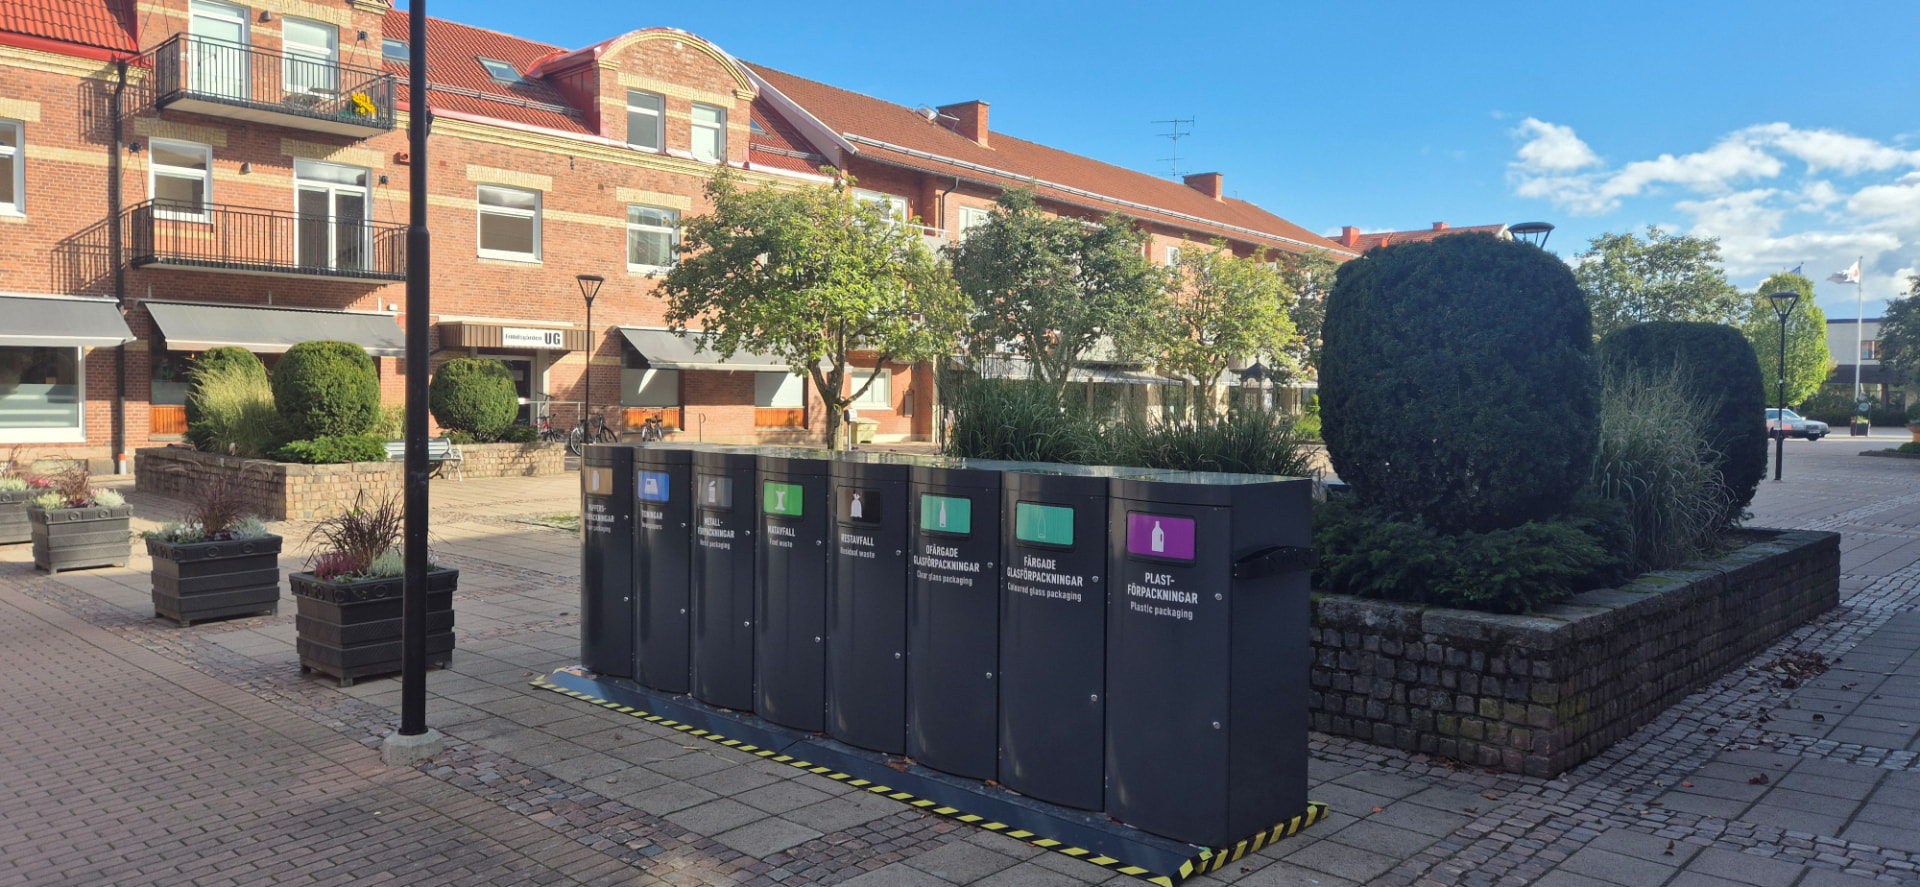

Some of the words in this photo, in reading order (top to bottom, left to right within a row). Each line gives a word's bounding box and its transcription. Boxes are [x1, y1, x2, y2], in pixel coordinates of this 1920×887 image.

[544, 332, 561, 345] UG
[767, 525, 795, 537] MATAVFALL
[841, 533, 874, 546] RESTAVFALL
[859, 550, 875, 559] waste
[925, 543, 958, 558] OFÄRGADE
[913, 555, 980, 573] GLASFÖRPACKNINGAR
[1023, 555, 1056, 570] FÄRGADE
[928, 572, 942, 583] glass
[942, 574, 973, 587] packaging
[1006, 566, 1083, 587] GLASFÖRPACKNINGAR
[1144, 572, 1175, 586] PLAST-
[1007, 582, 1029, 594] Coloured
[1029, 586, 1046, 598] glass
[1047, 589, 1082, 603] packaging
[1127, 583, 1198, 604] FÖRPACKNINGAR
[1130, 601, 1153, 614] Plastic
[1154, 604, 1193, 621] packaging
